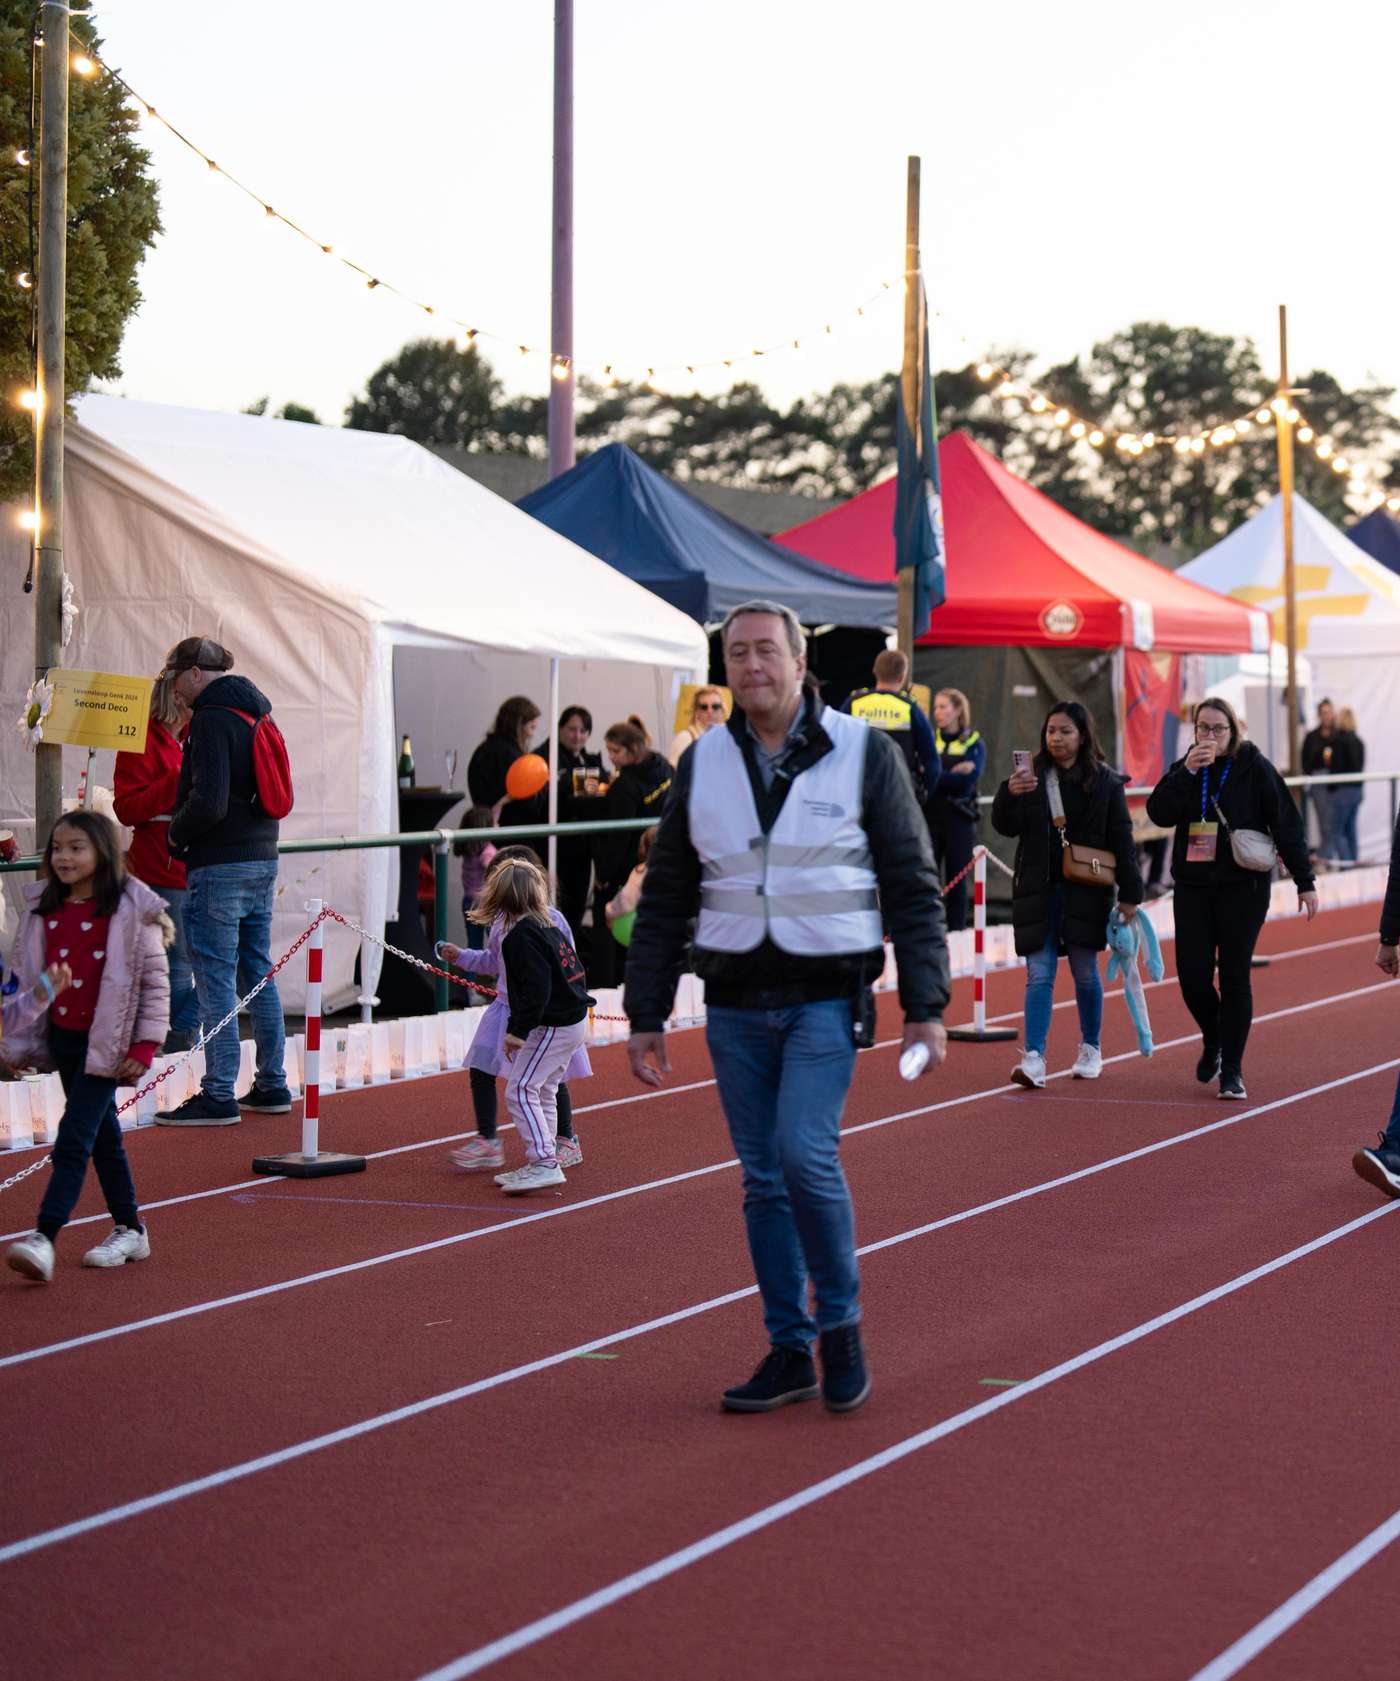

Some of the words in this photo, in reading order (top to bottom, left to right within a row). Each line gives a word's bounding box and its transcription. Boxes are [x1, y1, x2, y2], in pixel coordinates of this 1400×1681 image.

[74, 698, 106, 710] Second
[108, 702, 128, 713] Deco
[118, 724, 137, 737] 112
